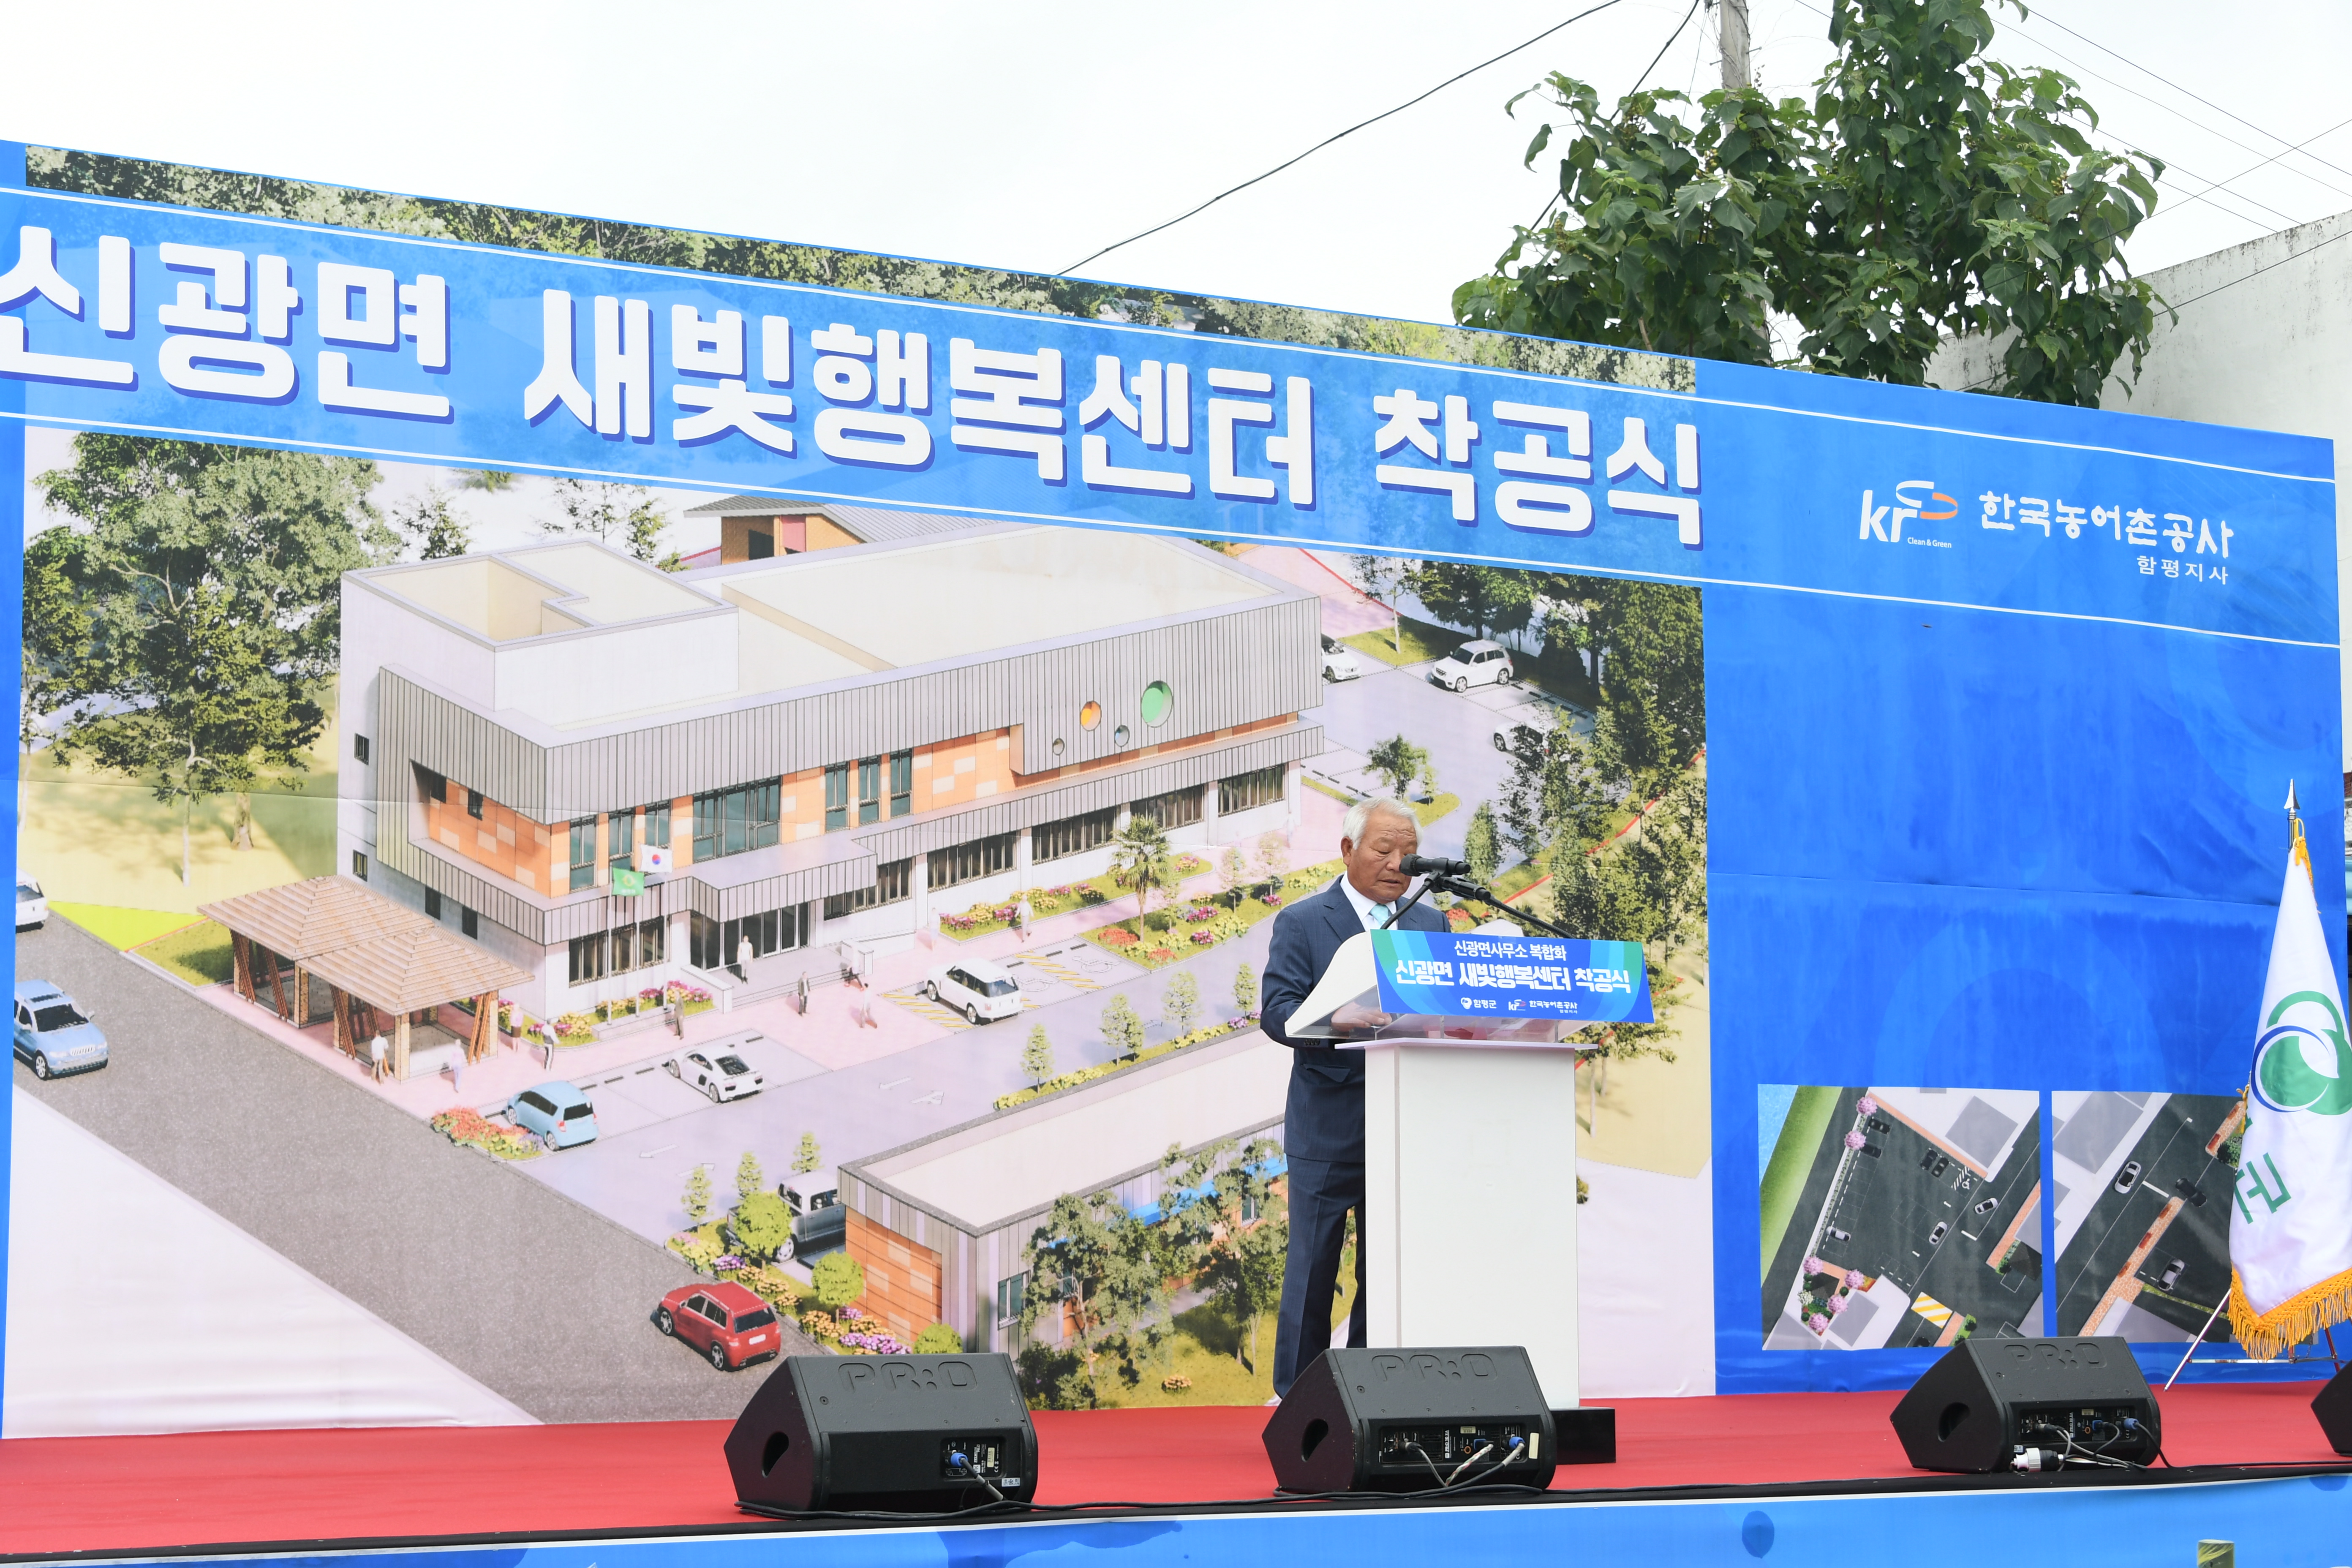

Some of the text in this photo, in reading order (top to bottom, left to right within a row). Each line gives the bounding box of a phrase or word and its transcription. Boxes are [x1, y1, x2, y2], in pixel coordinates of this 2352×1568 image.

[0, 226, 1701, 546] 신광면 새빛행복센터 착공식
[1979, 490, 2234, 558] 한국농어촌공사
[1907, 537, 1926, 546] Clean
[1932, 540, 1952, 548] Green
[2136, 555, 2228, 585] 함평지사
[1454, 940, 1567, 961] 신광면사무소 복합화
[1395, 960, 1631, 994] 신광면 새빛행복센터 착공식
[1473, 999, 1497, 1009] 함평군
